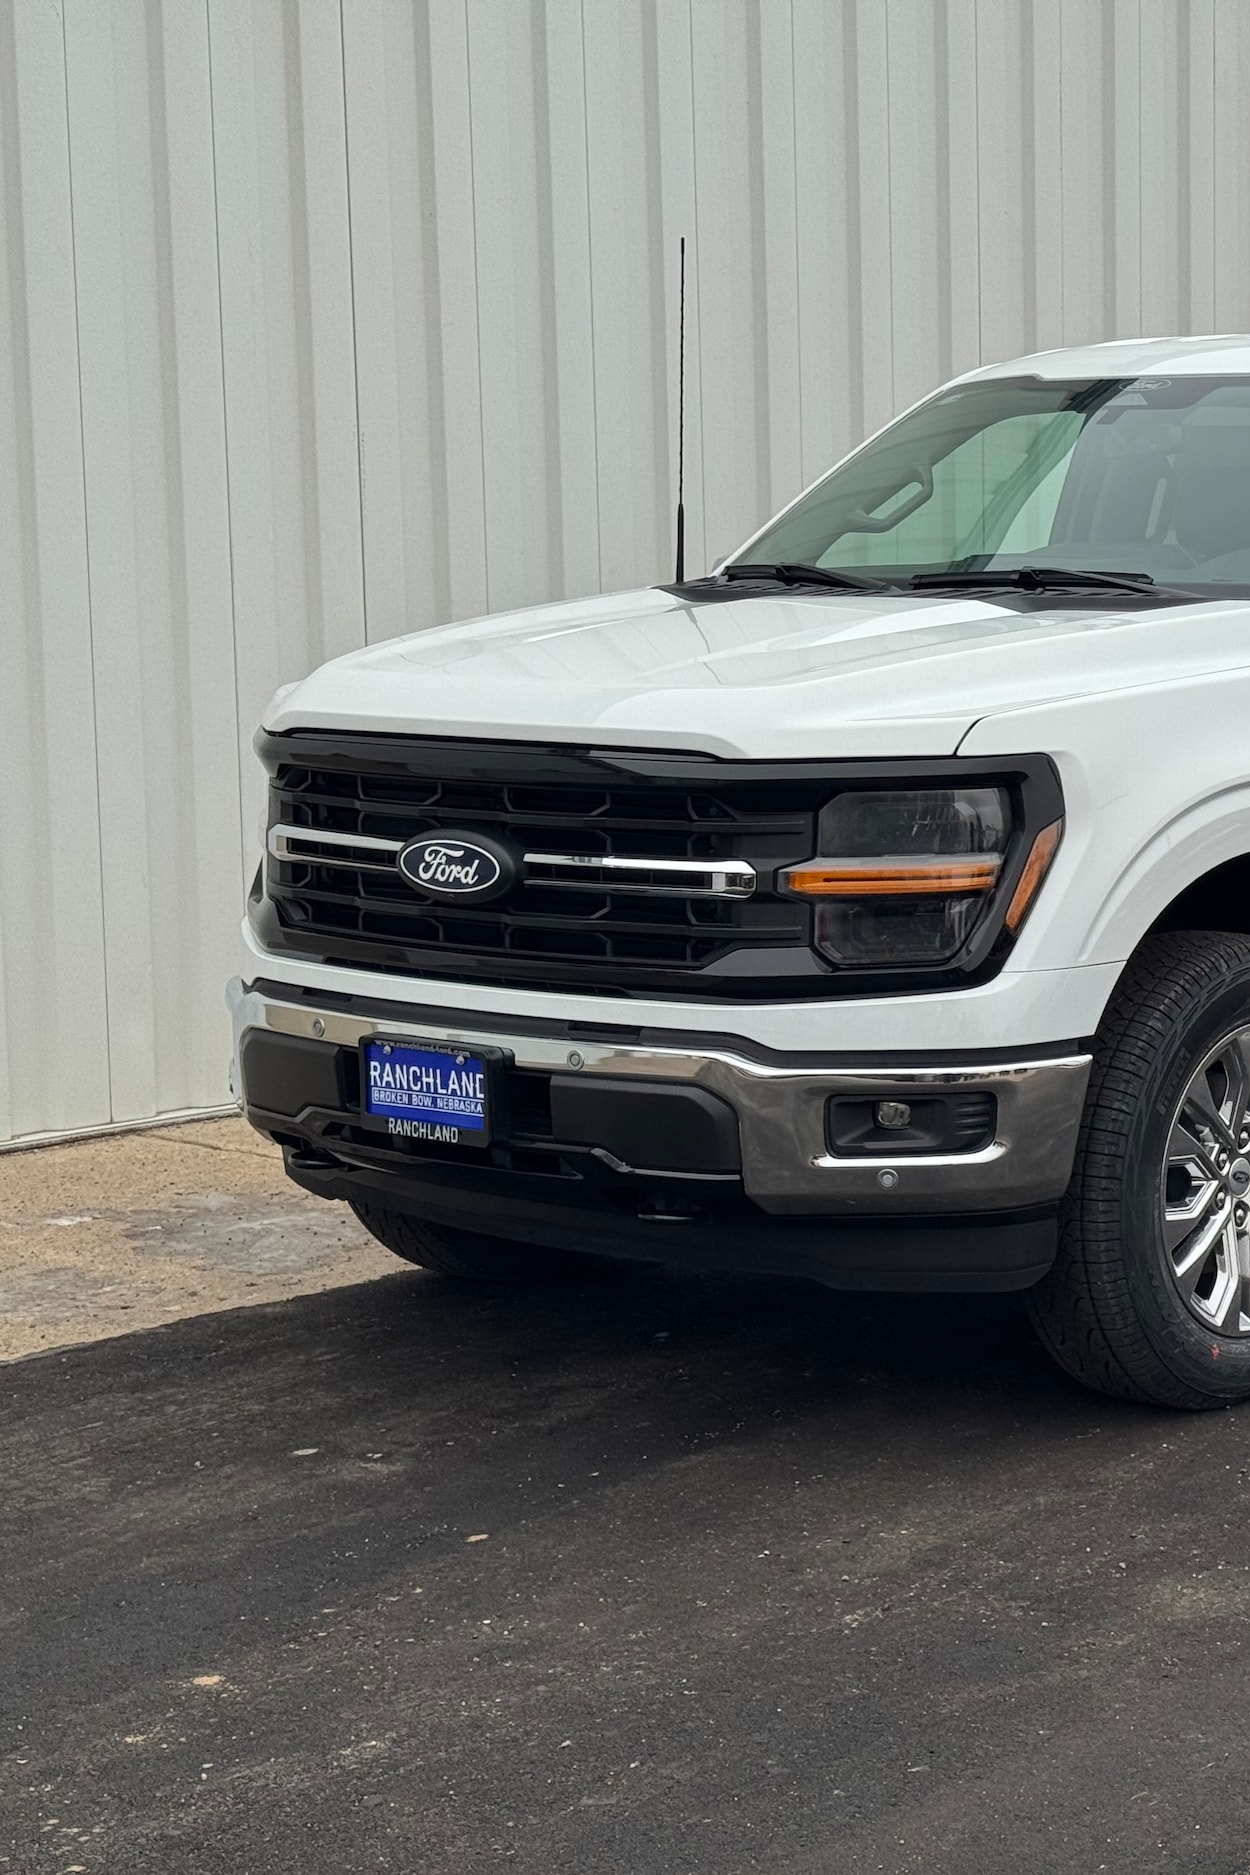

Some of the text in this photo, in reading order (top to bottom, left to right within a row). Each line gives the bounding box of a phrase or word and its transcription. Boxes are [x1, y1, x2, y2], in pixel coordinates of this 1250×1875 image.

[419, 846, 480, 884] Ford
[370, 1061, 485, 1099] RANCHLAND
[374, 1089, 408, 1104] BROKEN
[437, 1098, 483, 1113] NEBRASKA
[388, 1118, 458, 1143] RANCHLAND
